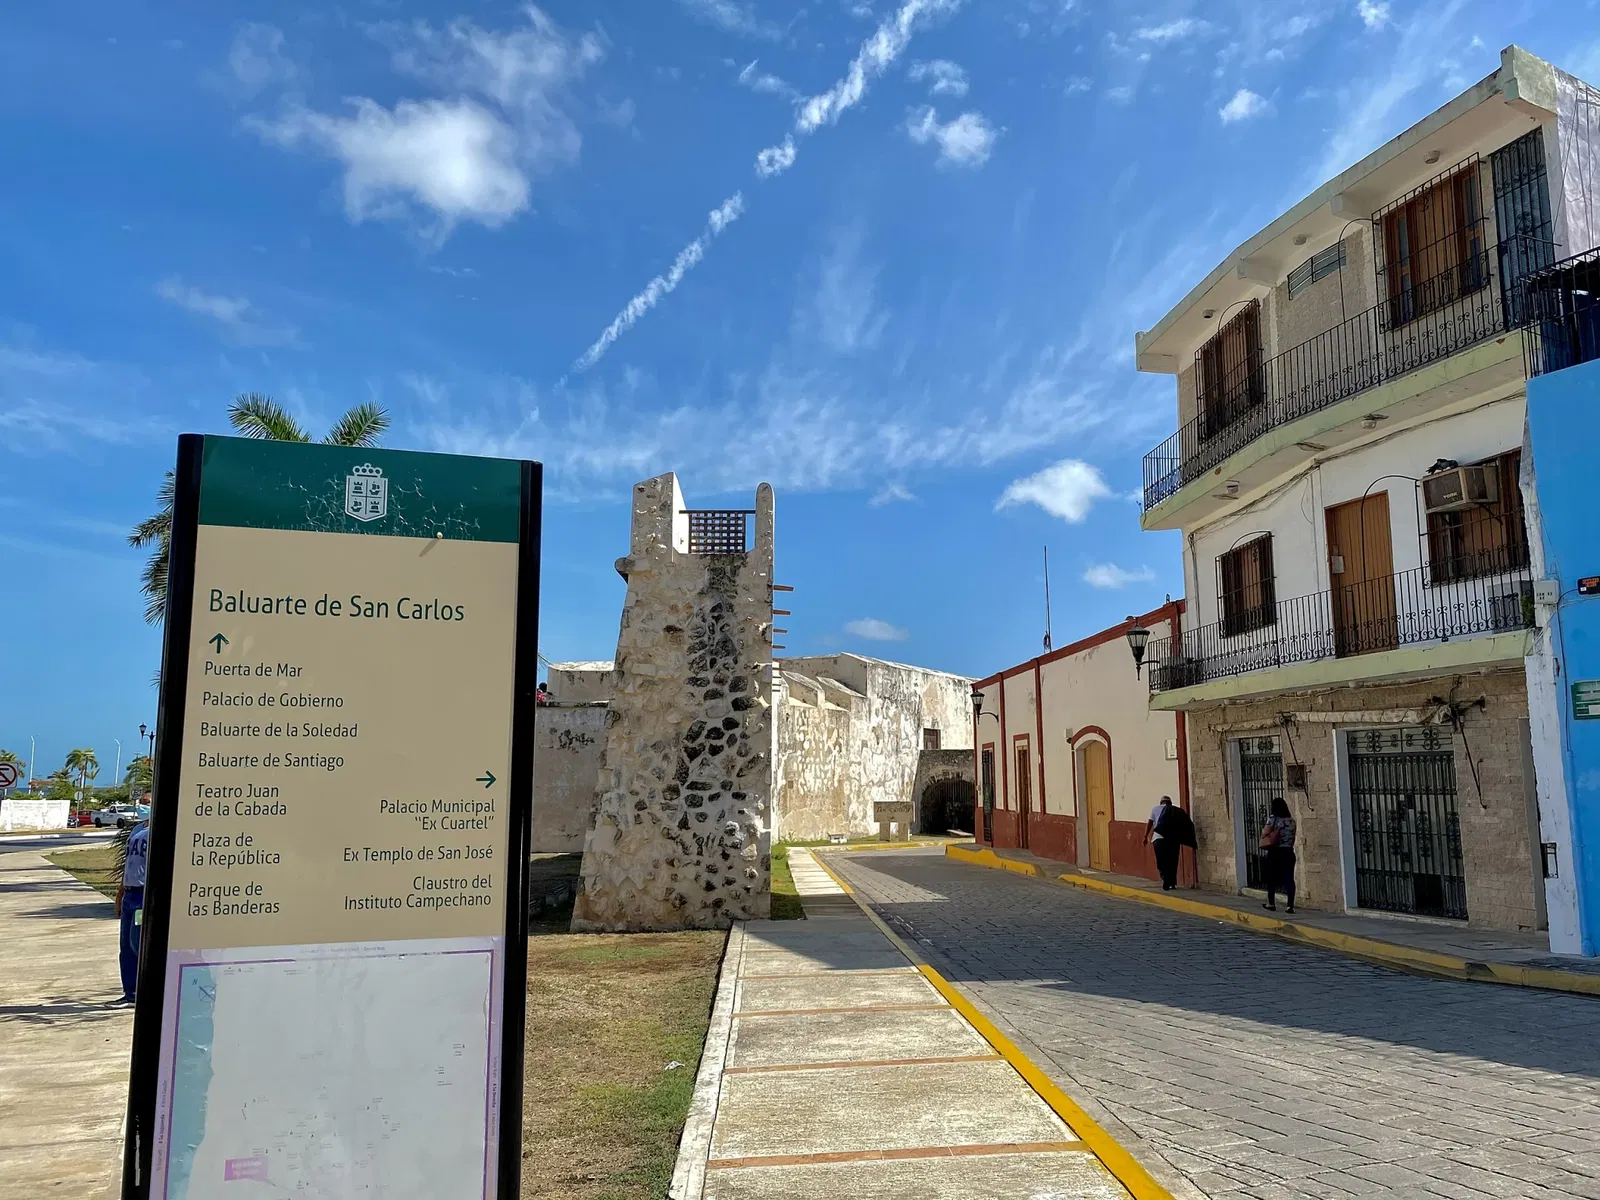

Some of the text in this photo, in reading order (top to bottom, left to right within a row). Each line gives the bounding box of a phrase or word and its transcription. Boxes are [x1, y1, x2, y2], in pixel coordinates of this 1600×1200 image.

[209, 588, 464, 621] Baluarte de San Carlos
[204, 660, 302, 677] Puerta de Mar
[202, 691, 343, 707] Palacio de Gobierno
[200, 721, 357, 737] Baluarte de la Soledad
[198, 752, 343, 771] Baluarte de Santiago
[196, 783, 278, 798] Teatro Juan
[194, 800, 286, 816] de la Cabada
[380, 798, 495, 815] Palacio Municipal
[192, 831, 253, 847] Plaza de
[191, 849, 280, 869] la República
[343, 845, 492, 865] Ex Templo de San José
[412, 873, 492, 890] Claustro del
[189, 881, 262, 901] Parque de
[187, 899, 279, 916] las Banderas
[344, 893, 491, 911] Instituto Campechano
